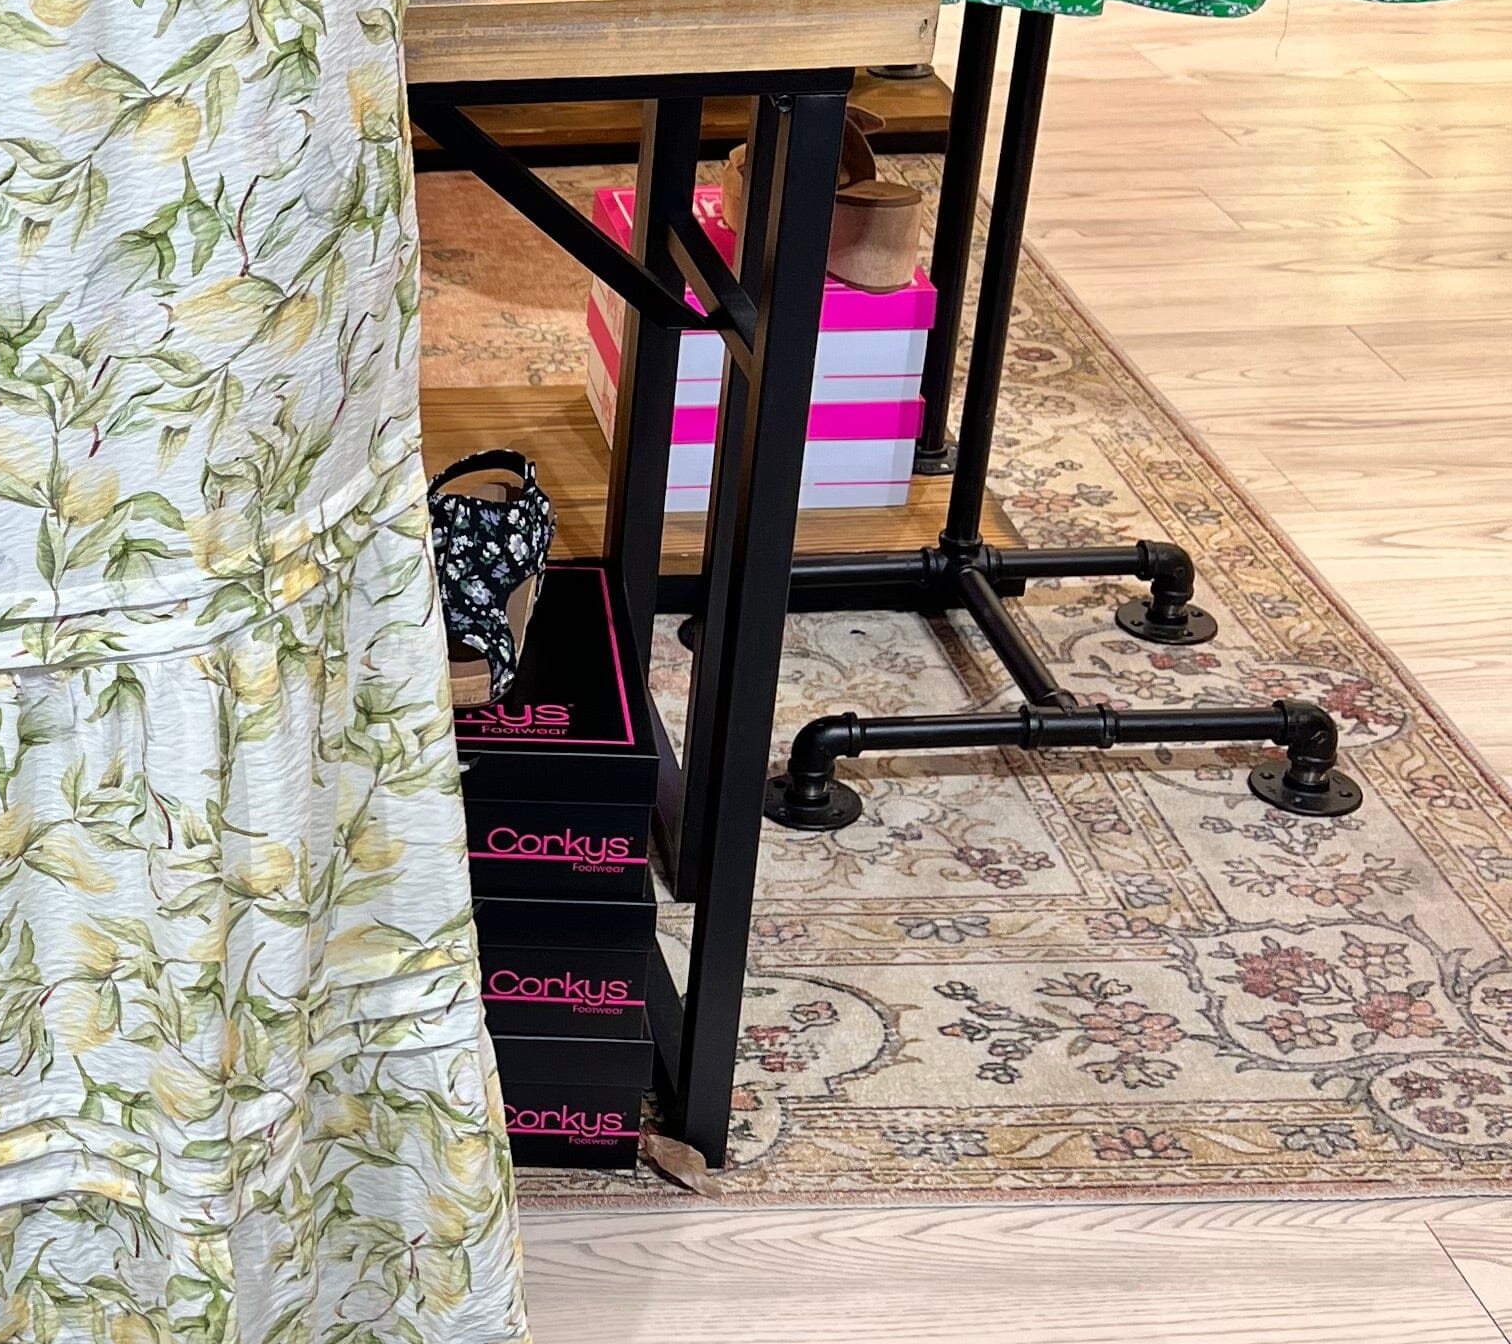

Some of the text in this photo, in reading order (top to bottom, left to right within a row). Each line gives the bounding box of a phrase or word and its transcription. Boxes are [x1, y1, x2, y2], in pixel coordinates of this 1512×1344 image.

[481, 725, 568, 735] Footwear
[487, 826, 630, 865] Corkys
[572, 862, 625, 873] Footwear
[489, 969, 629, 1006] Corkys
[572, 1004, 624, 1015] Footwear
[568, 1136, 619, 1145] Footwear
